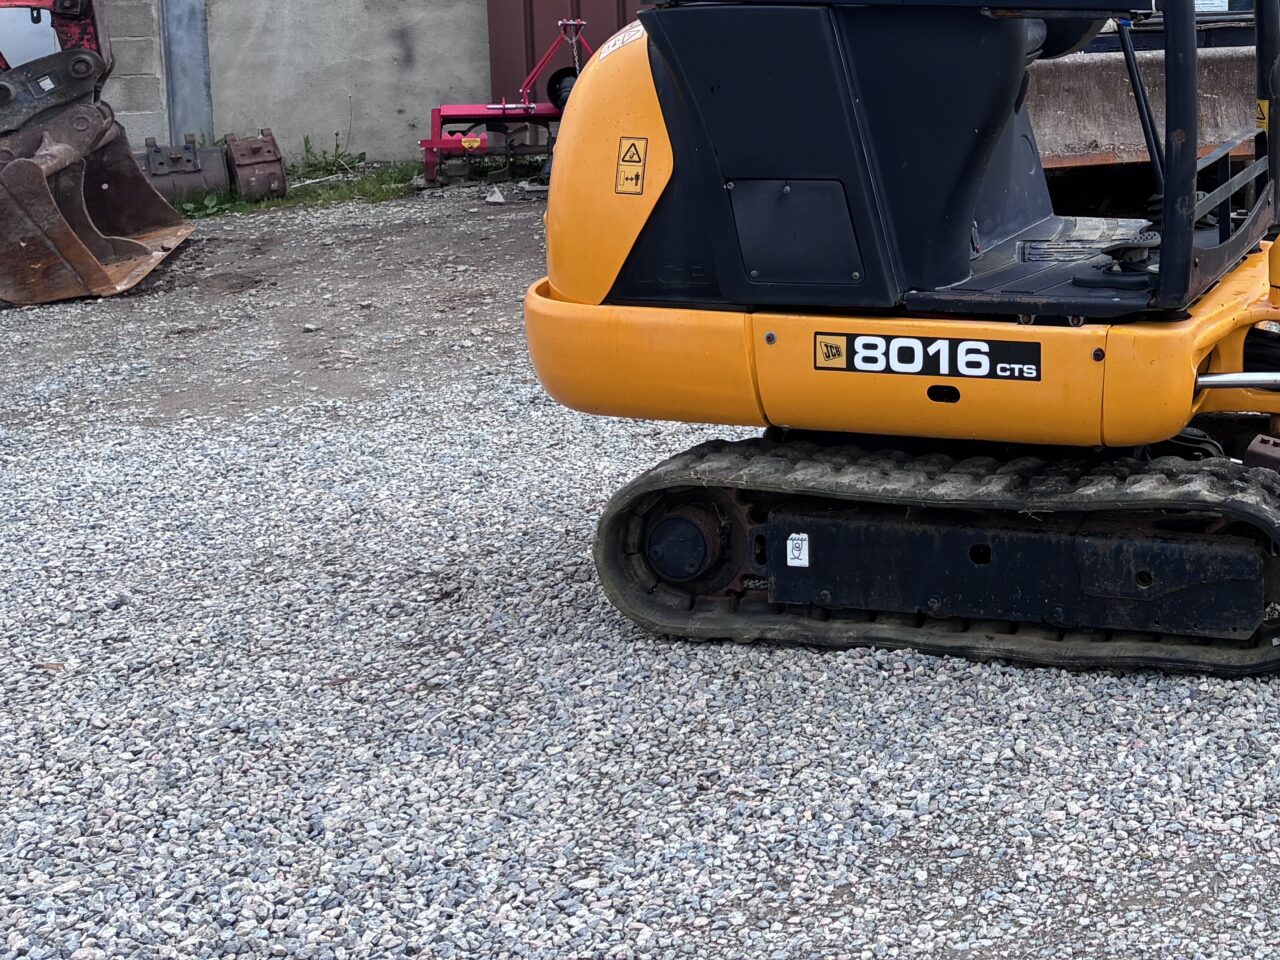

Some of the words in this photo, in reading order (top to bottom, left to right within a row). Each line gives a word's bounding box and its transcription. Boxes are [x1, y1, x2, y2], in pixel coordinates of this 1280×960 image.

[823, 343, 842, 359] JCB
[853, 336, 990, 376] 8016
[996, 363, 1037, 377] CTS
